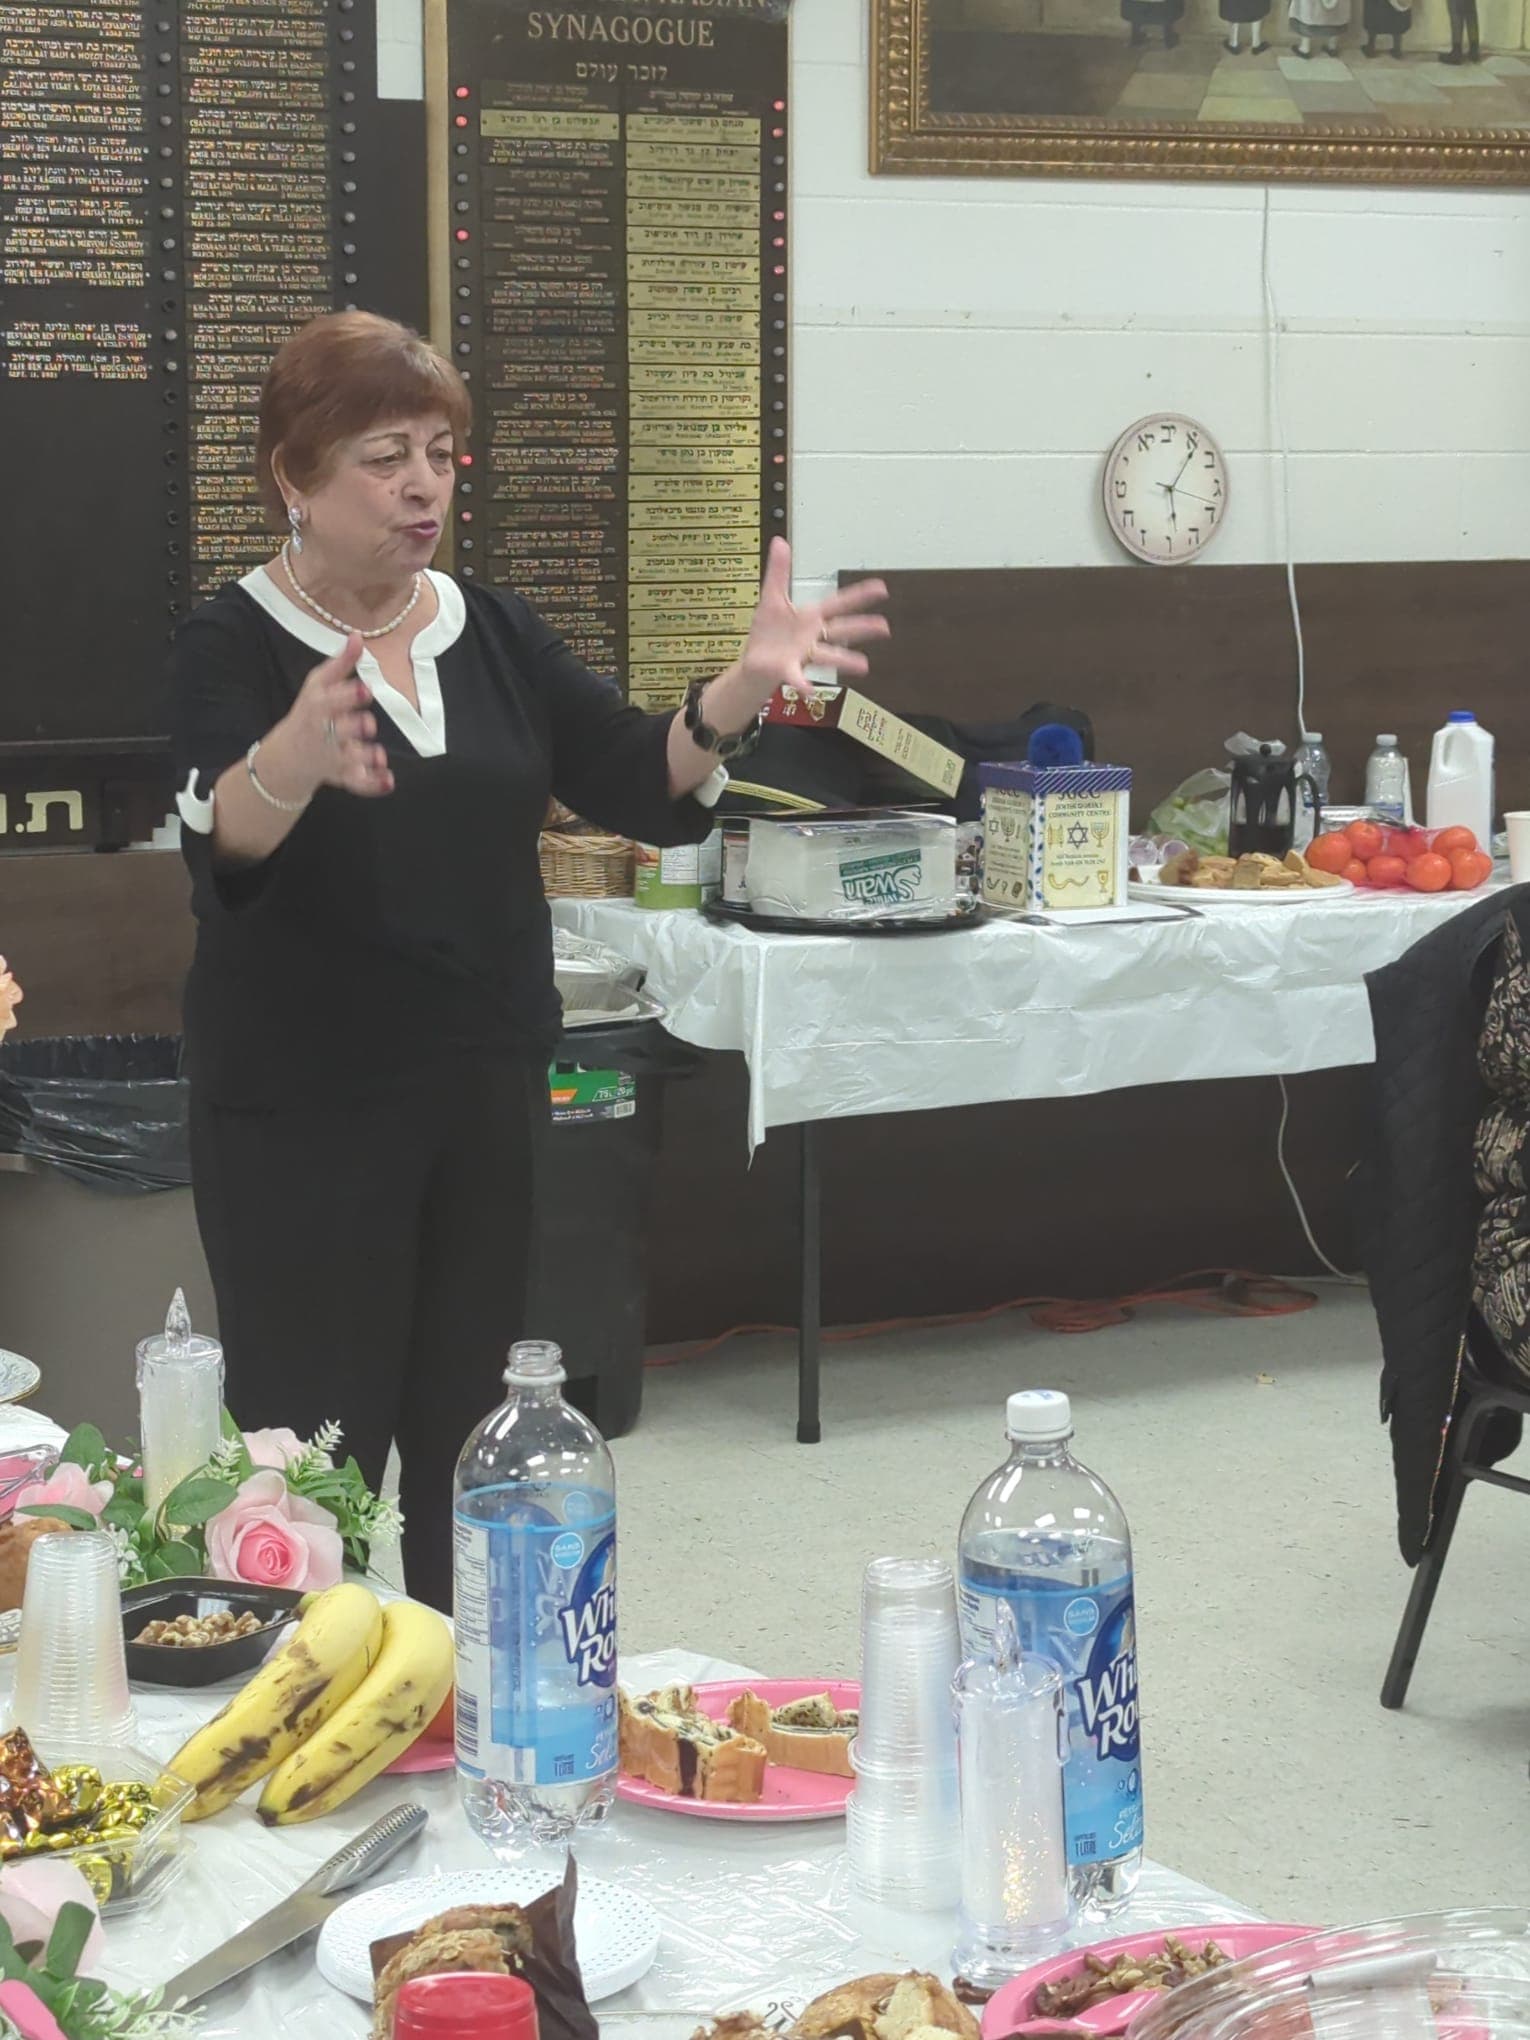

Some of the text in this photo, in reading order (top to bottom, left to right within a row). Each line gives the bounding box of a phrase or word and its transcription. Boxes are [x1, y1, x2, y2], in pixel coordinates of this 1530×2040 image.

[527, 11, 714, 47] SYNAGOGUE
[576, 61, 668, 82] לזכר עולם
[1137, 434, 1155, 452] יא
[1161, 425, 1176, 443] יב
[1187, 432, 1198, 449] א
[1123, 456, 1129, 466] י
[1204, 451, 1215, 469] ב
[1115, 480, 1127, 498] ט
[1213, 479, 1222, 497] ג
[1123, 510, 1134, 528] ח
[1204, 507, 1215, 524] ד
[1140, 529, 1146, 546] ז
[1166, 536, 1172, 553] ו
[1188, 528, 1199, 545] ה
[841, 865, 921, 901] Swan
